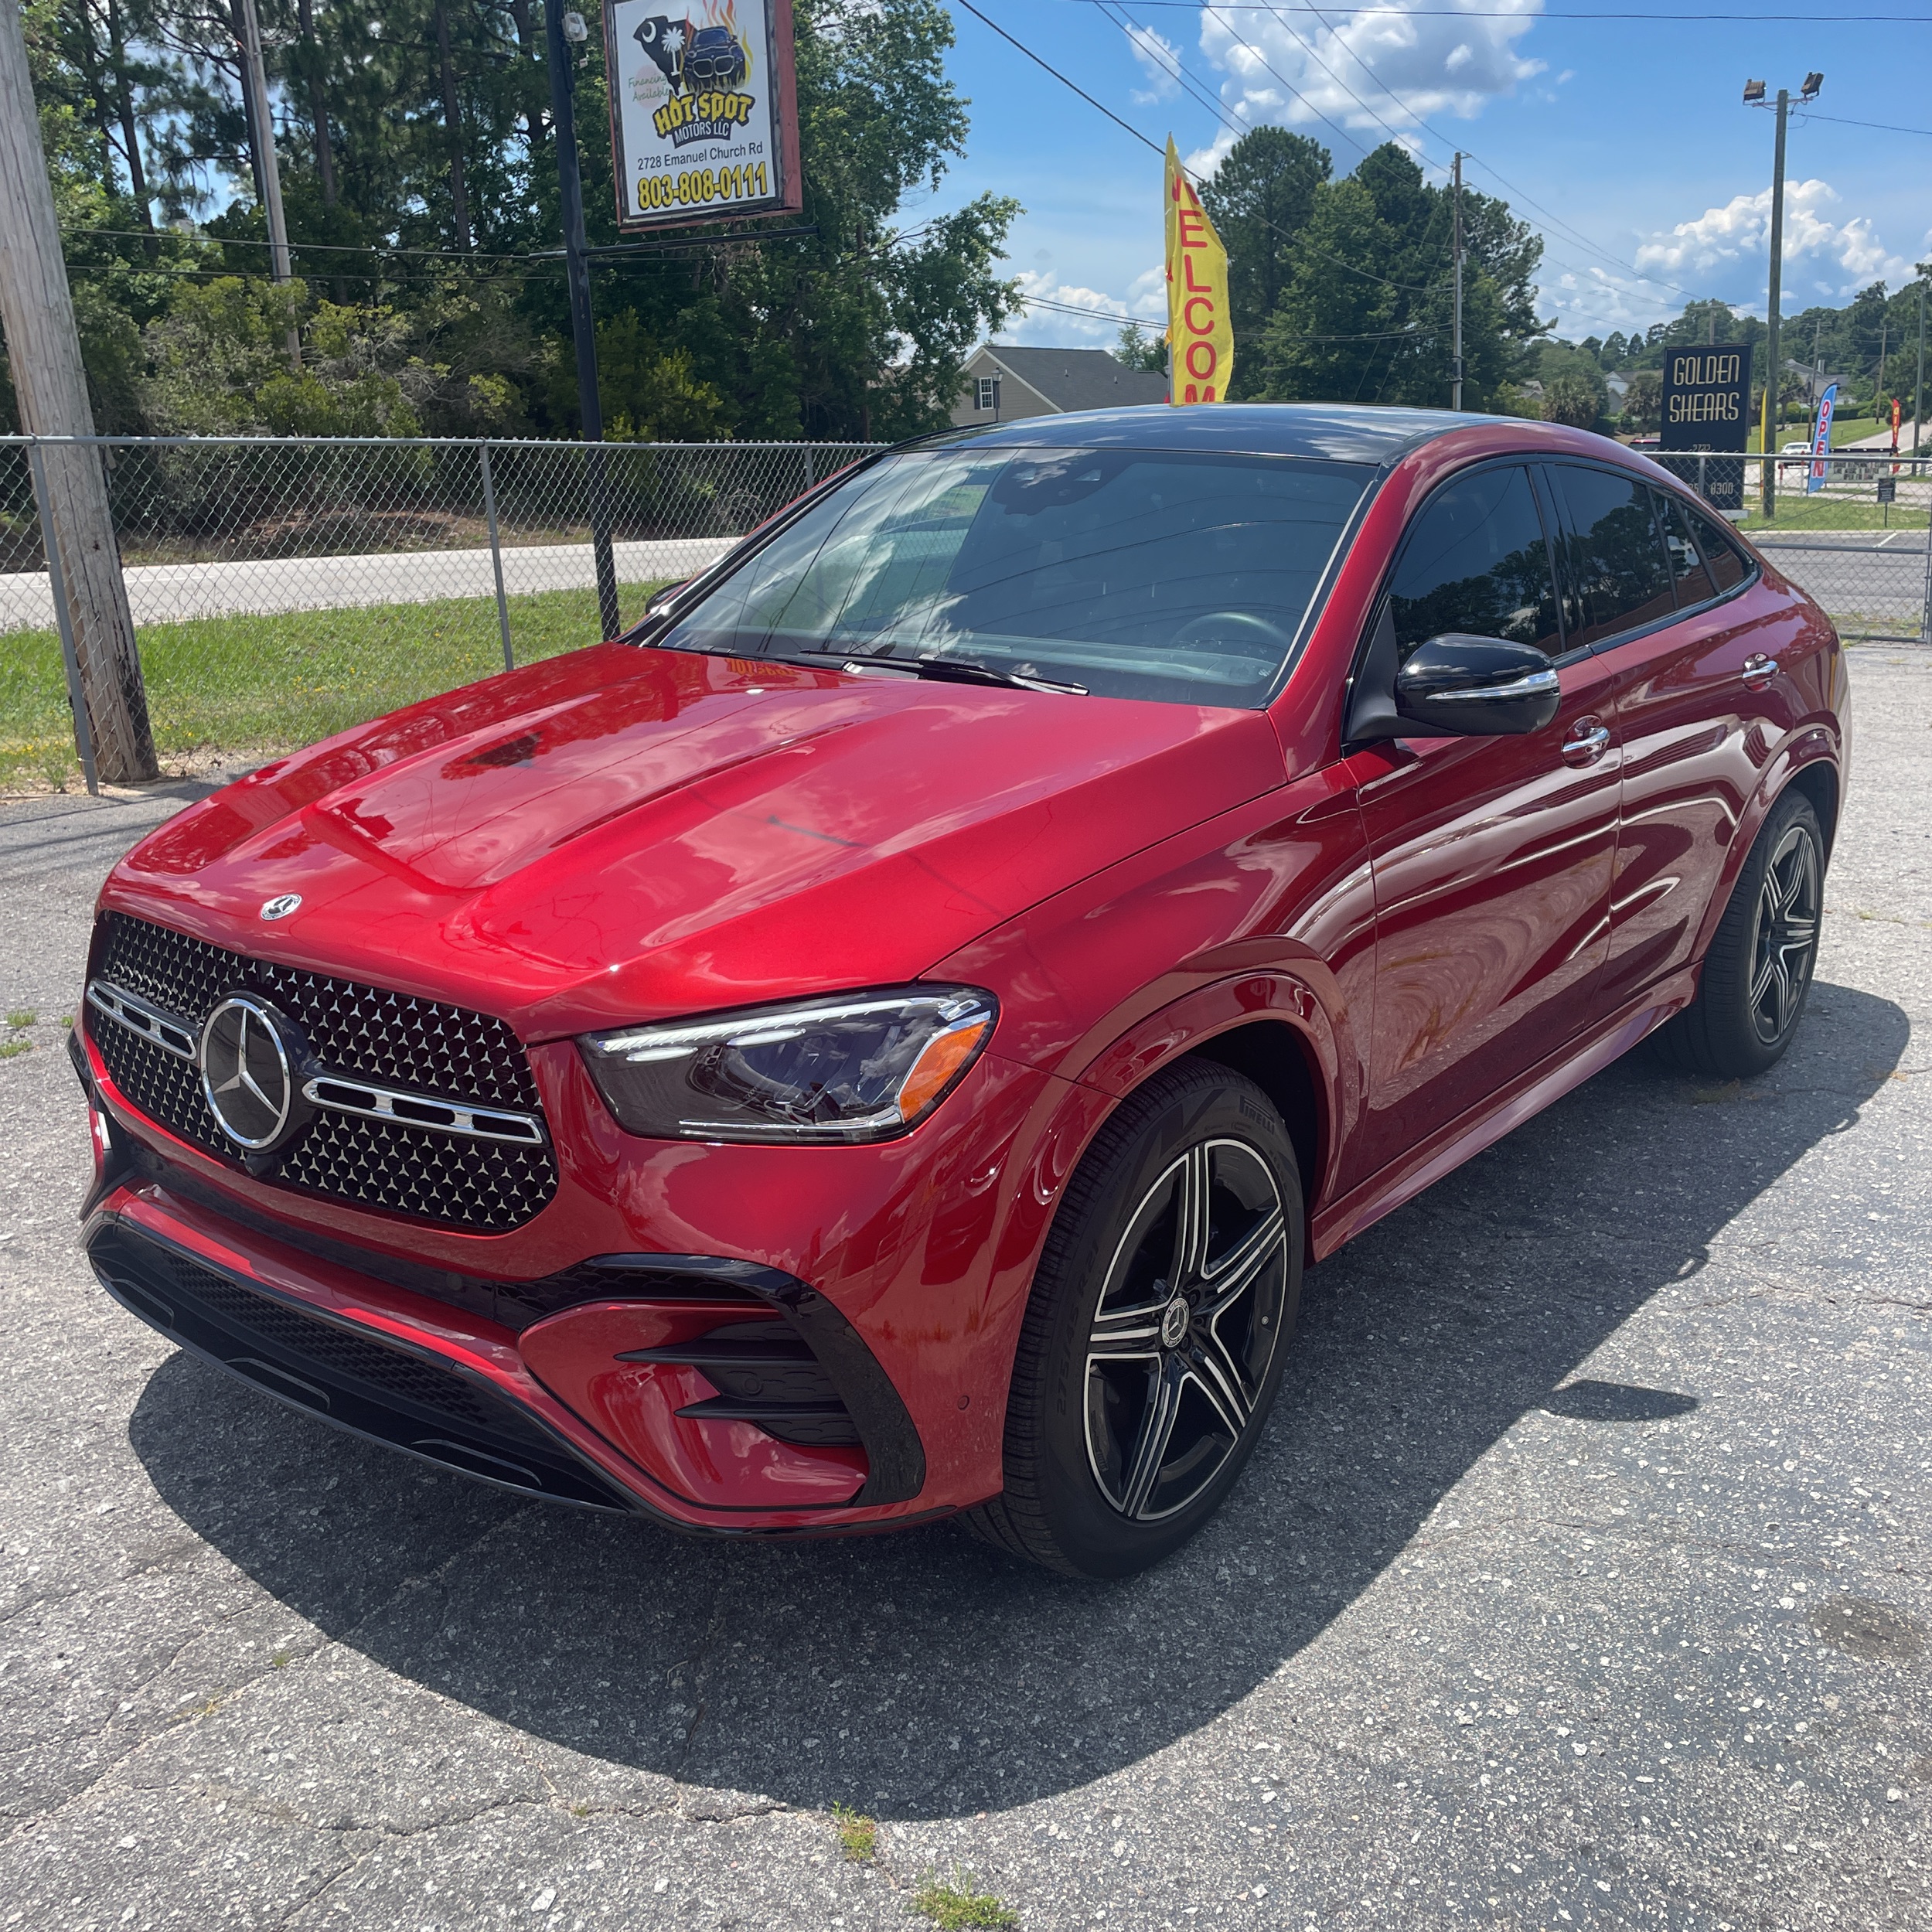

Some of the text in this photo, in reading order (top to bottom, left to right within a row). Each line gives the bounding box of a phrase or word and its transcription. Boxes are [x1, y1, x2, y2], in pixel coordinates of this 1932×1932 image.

[628, 74, 667, 89] Financing
[632, 87, 670, 102] Available
[654, 91, 753, 135] HOT SPOT
[674, 121, 730, 144] MOTORS LLC
[638, 141, 763, 170] 2728 Emanuel Church Rd
[638, 161, 768, 210] 803-808-0111
[1673, 355, 1740, 386] GOLDEN
[1669, 391, 1740, 423] SHEARS
[1812, 400, 1830, 477] OPEN
[1239, 1095, 1276, 1136] PIRELLI
